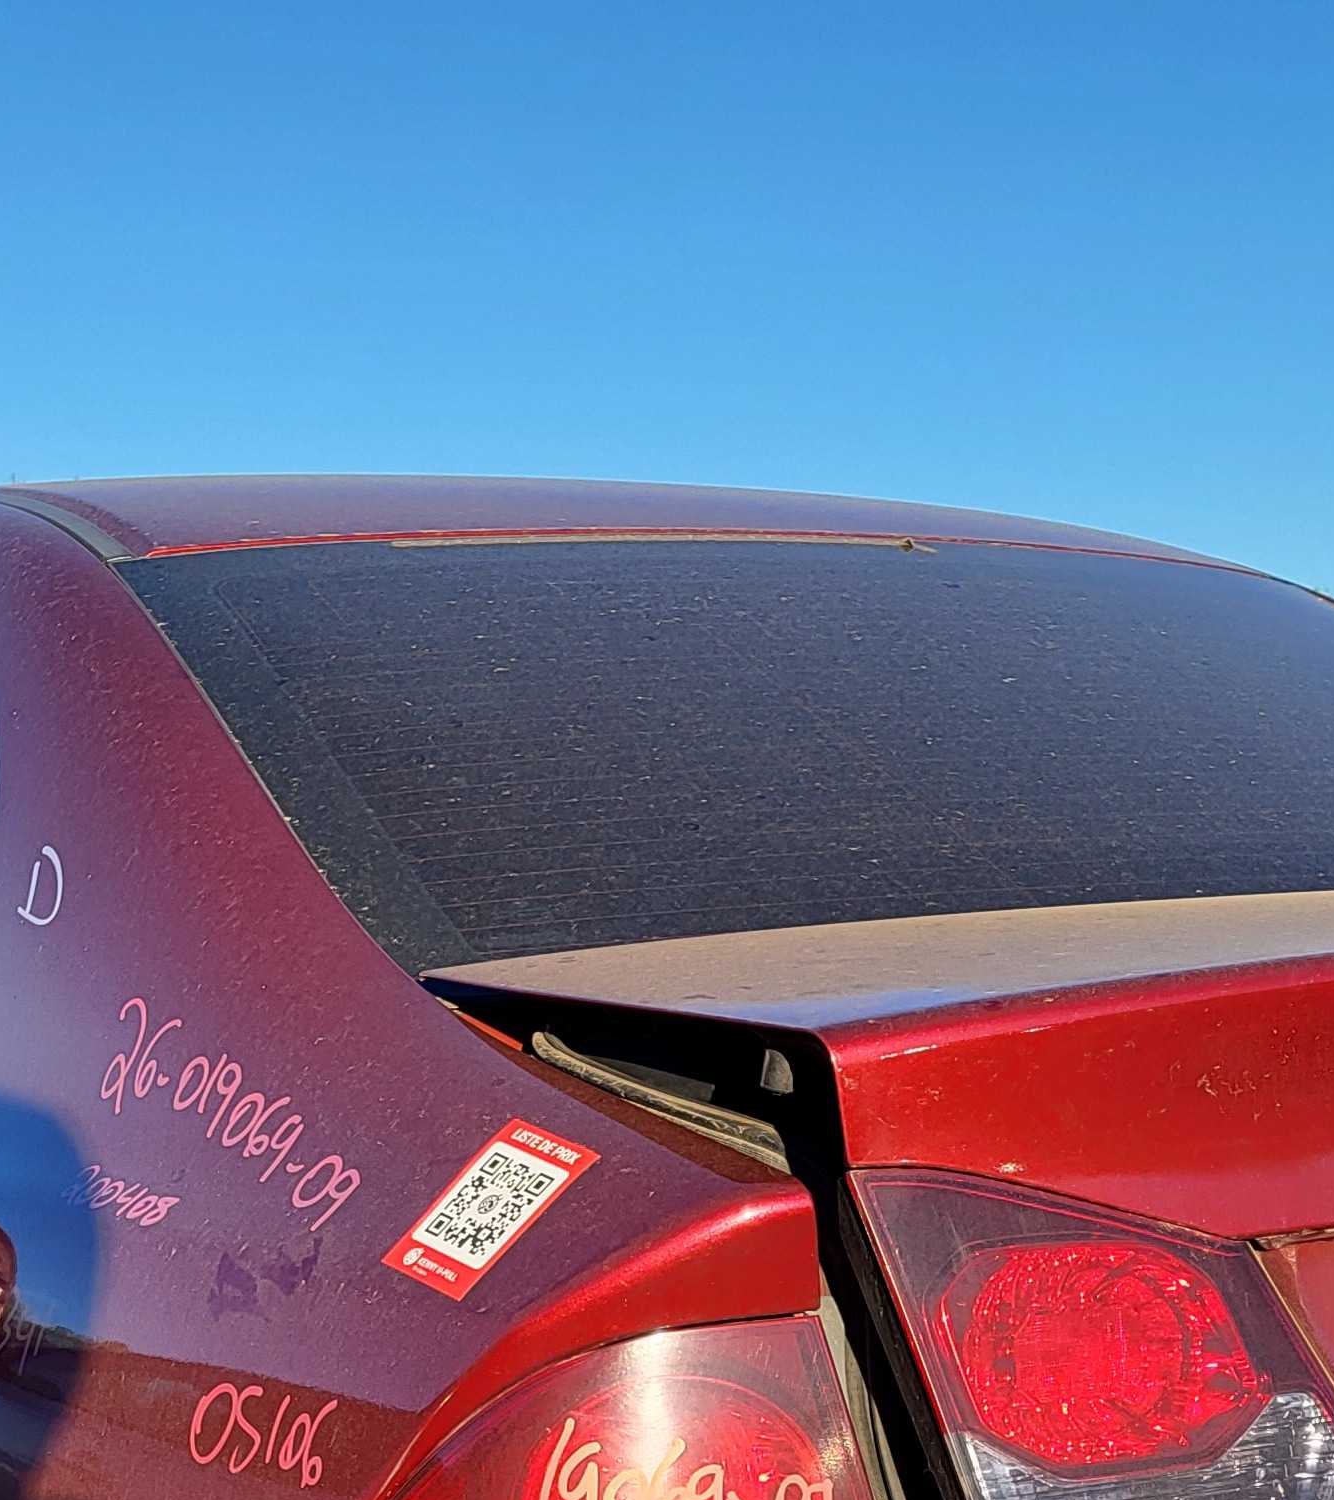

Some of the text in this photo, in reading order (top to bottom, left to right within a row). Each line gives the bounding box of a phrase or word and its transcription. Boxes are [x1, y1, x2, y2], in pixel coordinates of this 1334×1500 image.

[17, 846, 64, 926] D
[510, 1128, 583, 1166] LISTE DE PRIX
